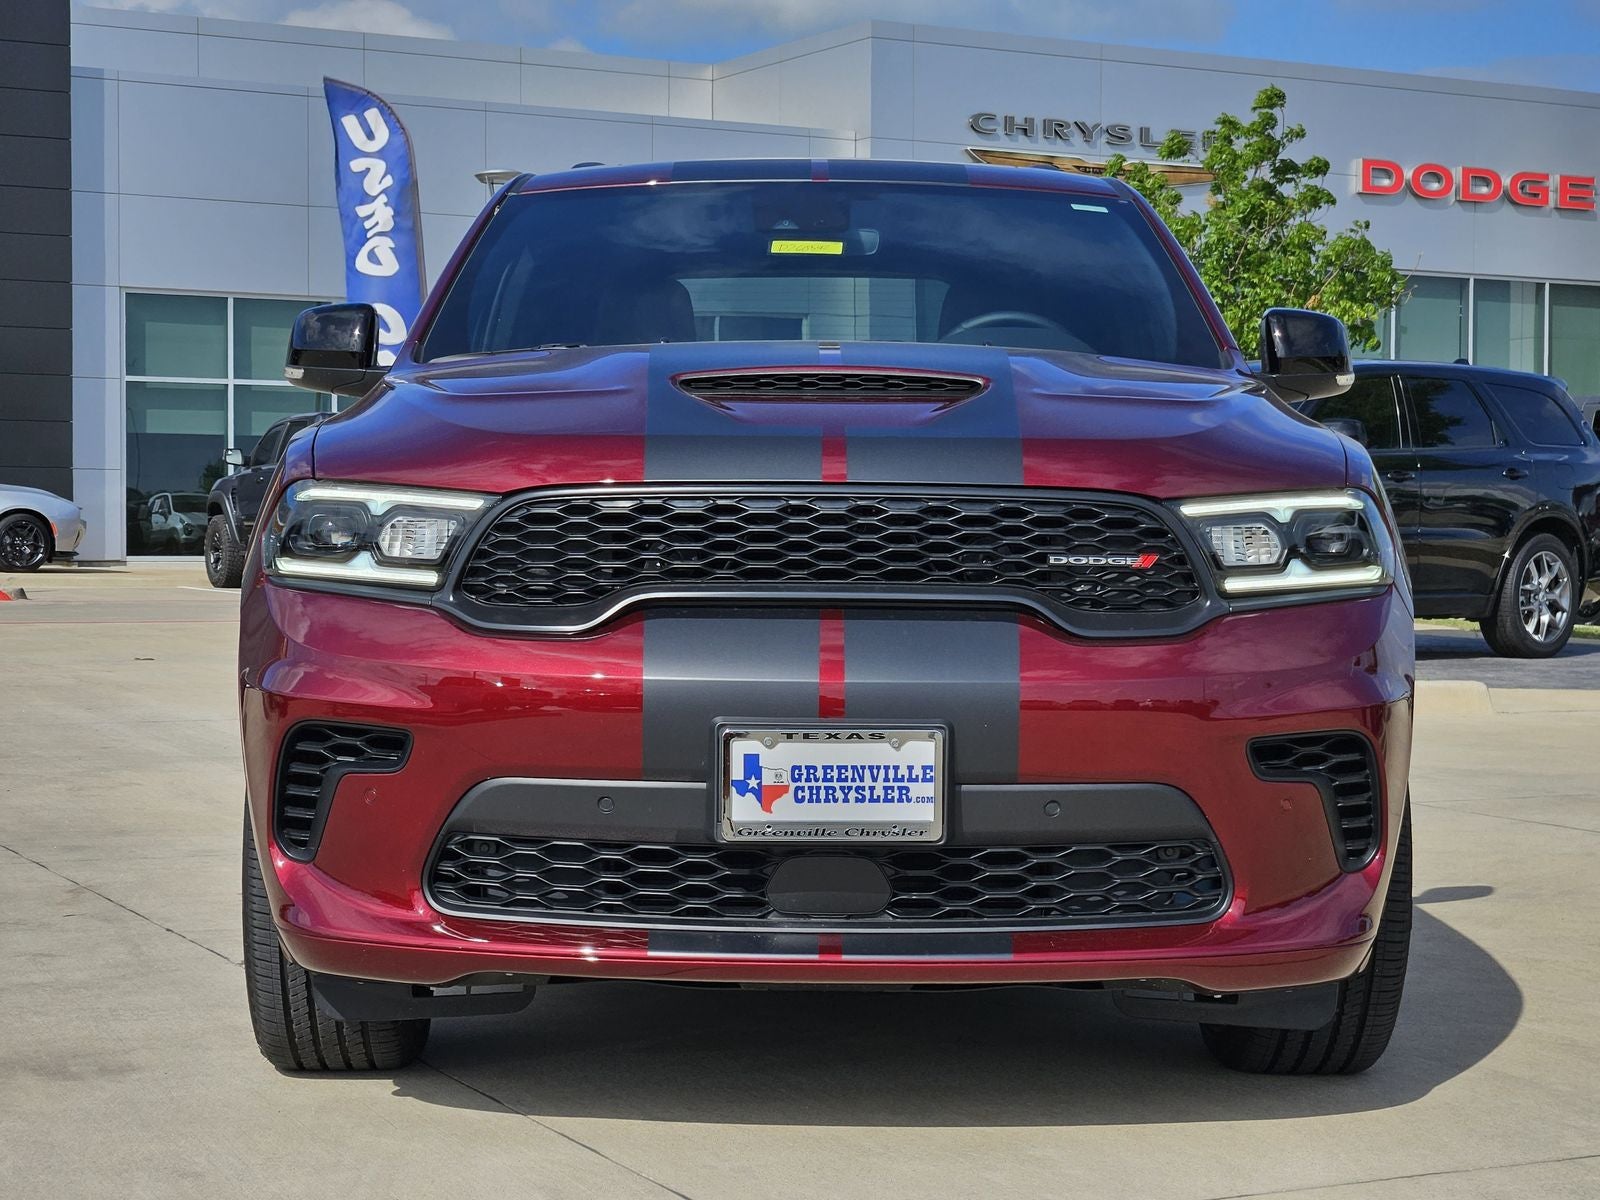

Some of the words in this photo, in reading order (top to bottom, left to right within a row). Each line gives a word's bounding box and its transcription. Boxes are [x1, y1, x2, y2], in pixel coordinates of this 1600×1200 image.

[1356, 158, 1596, 210] DODGE
[1049, 556, 1142, 565] DODGE
[781, 732, 886, 740] TEXAS
[790, 765, 934, 783] GREENVILLE
[737, 825, 838, 838] Greenville
[844, 825, 928, 838] Chrysler
